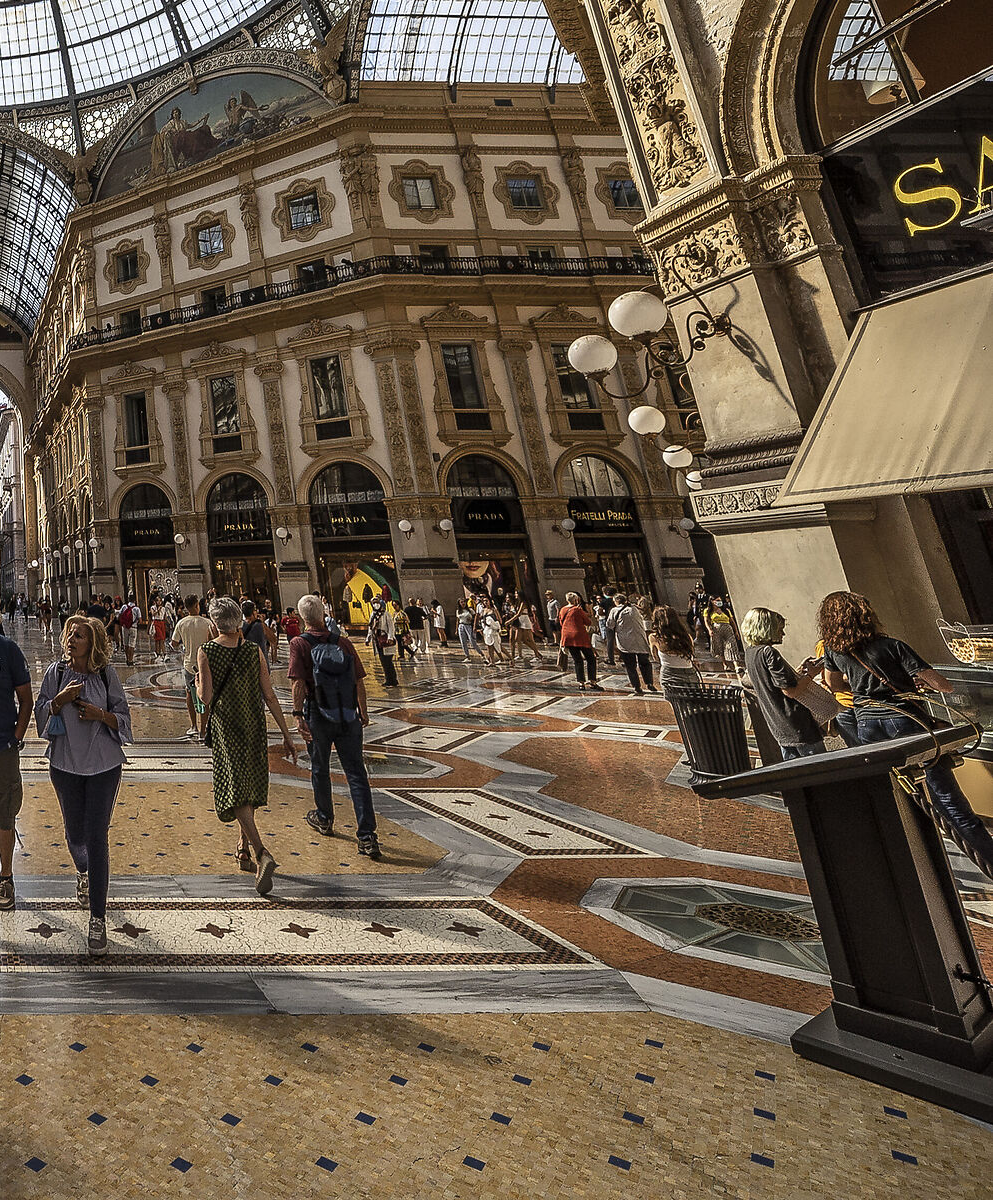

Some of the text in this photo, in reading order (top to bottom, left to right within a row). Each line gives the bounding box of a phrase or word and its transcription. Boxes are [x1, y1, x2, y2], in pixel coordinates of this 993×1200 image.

[331, 515, 367, 524] PRADA
[570, 509, 633, 521] FRATELLI PRADA
[224, 522, 254, 531] PRADA
[134, 528, 160, 536] PRADA
